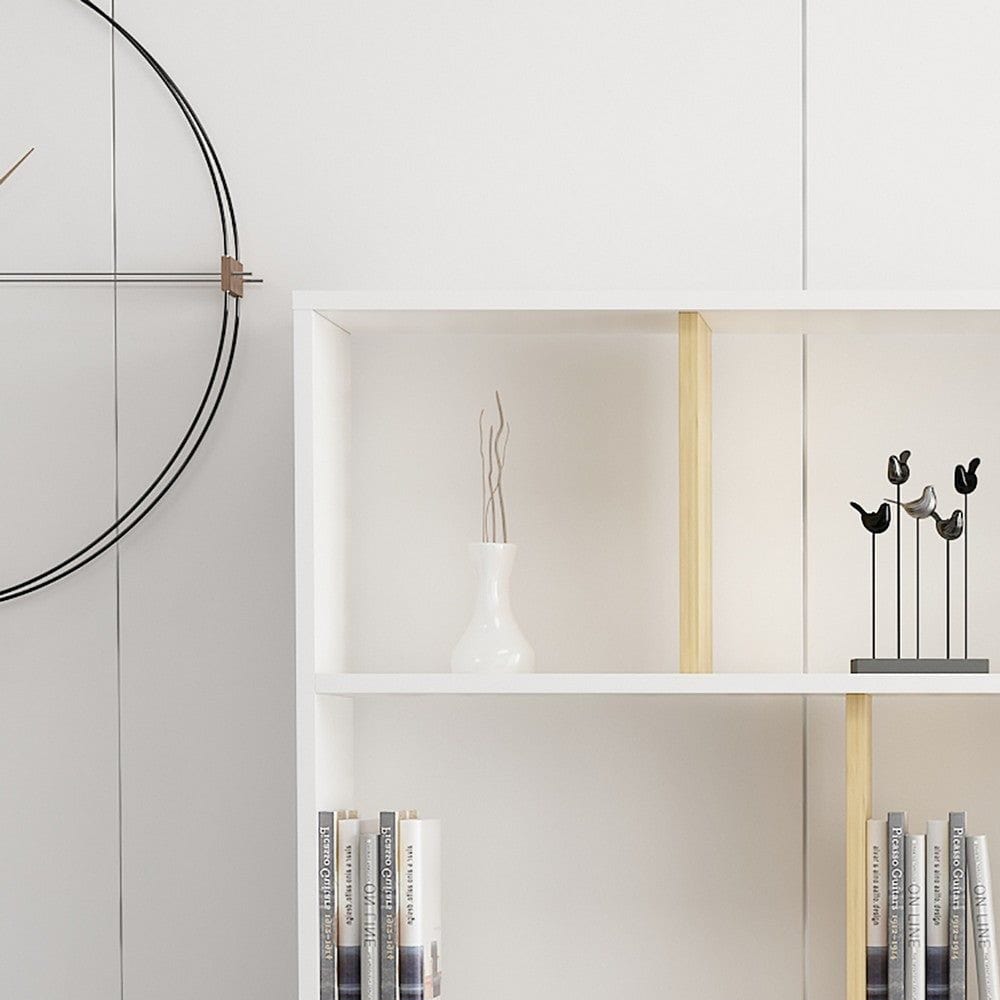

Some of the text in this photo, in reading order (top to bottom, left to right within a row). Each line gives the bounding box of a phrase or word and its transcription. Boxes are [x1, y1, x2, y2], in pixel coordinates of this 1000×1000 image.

[891, 828, 901, 866] Picasso
[953, 828, 962, 866] Picasso
[891, 869, 902, 910] Guitars
[907, 884, 920, 905] ON
[953, 869, 963, 910] Guitars
[974, 885, 987, 906] ON
[908, 914, 920, 948] LINE
[976, 915, 991, 949] LINE
